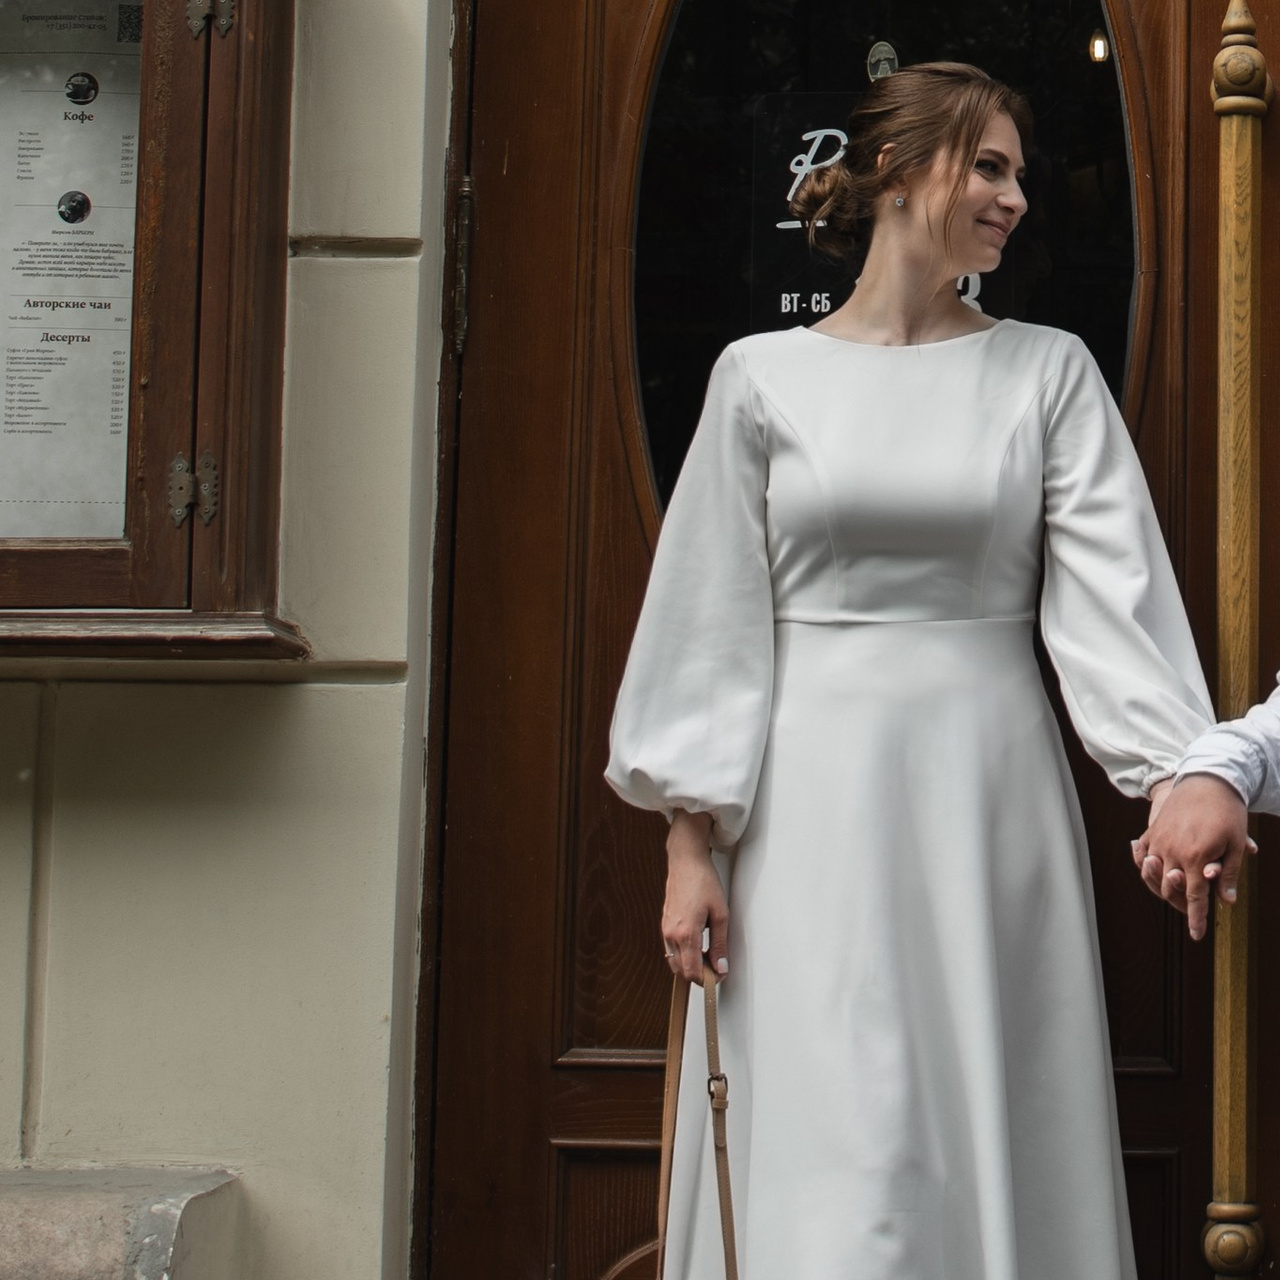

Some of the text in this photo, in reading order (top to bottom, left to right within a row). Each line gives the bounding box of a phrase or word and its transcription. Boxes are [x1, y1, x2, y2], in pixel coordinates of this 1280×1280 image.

[63, 111, 94, 124] Кофе
[23, 299, 111, 311] Авторские чаи
[40, 332, 91, 345] Десерты
